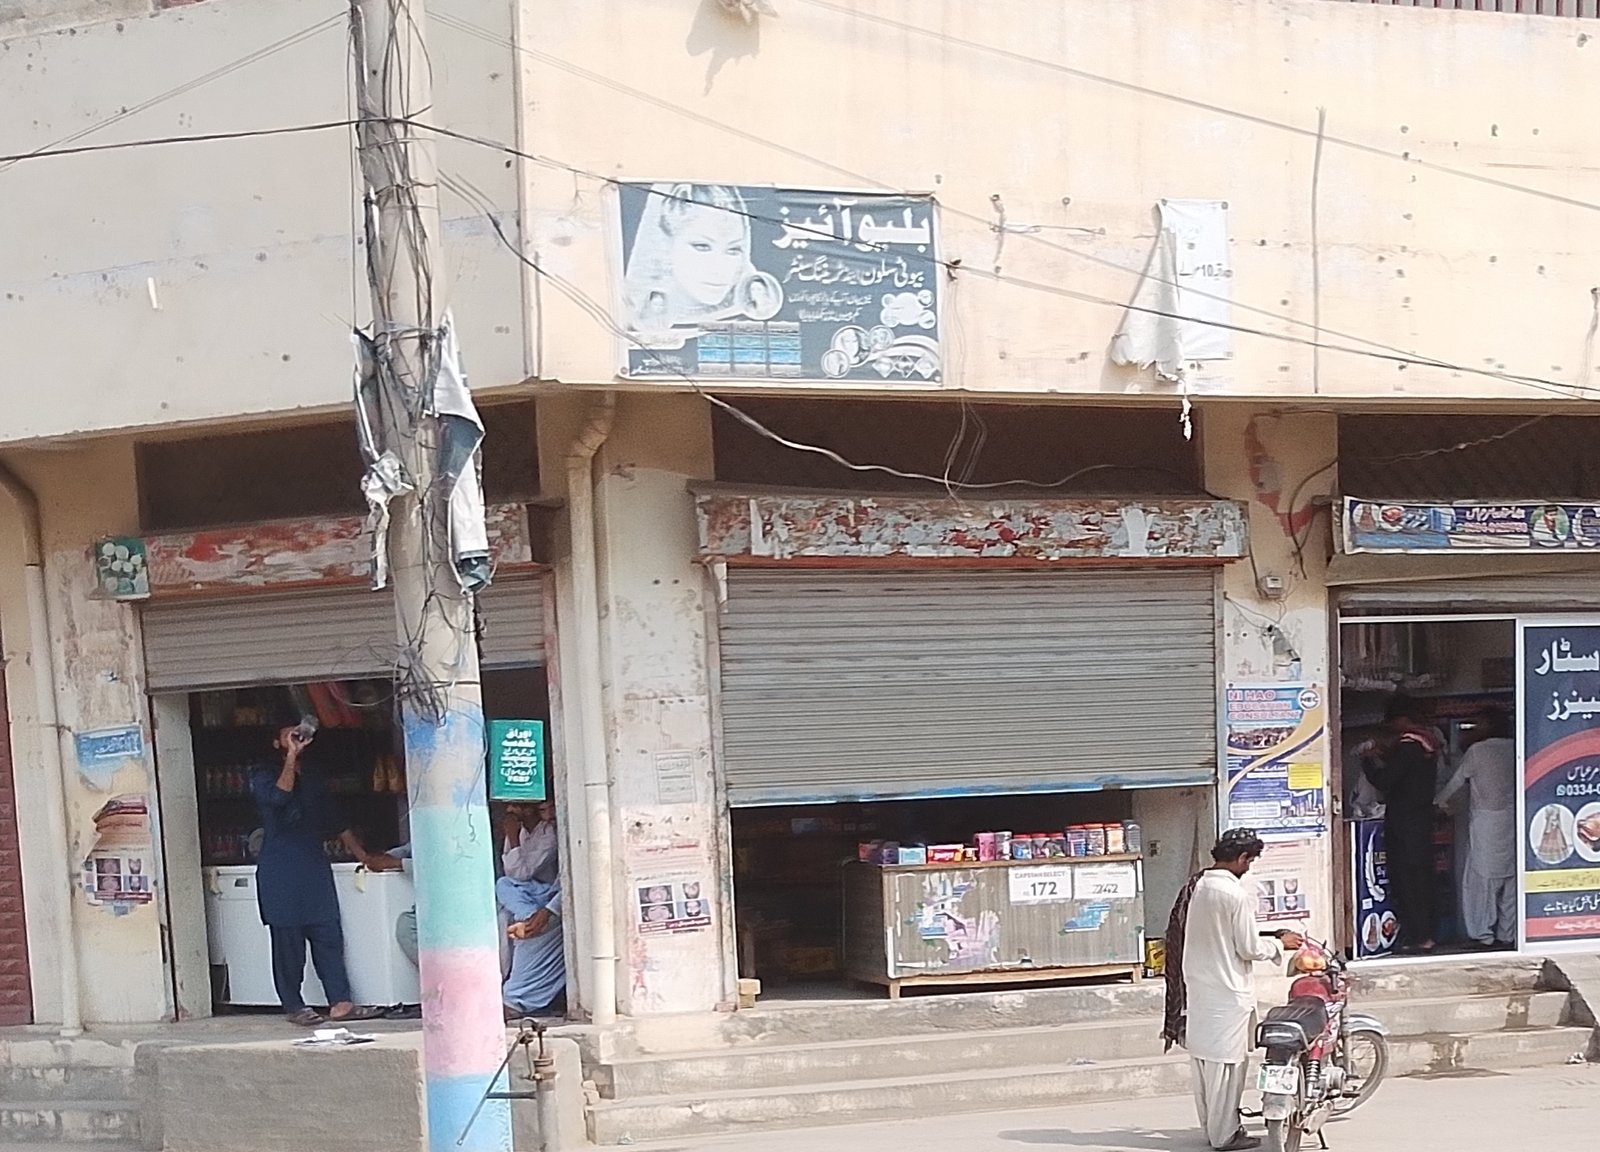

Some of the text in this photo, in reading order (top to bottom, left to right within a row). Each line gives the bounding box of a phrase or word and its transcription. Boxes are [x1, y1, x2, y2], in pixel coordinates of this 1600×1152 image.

[855, 206, 931, 253] بلیو
[1229, 690, 1275, 700] NI HAO
[1030, 881, 1058, 896] 172
